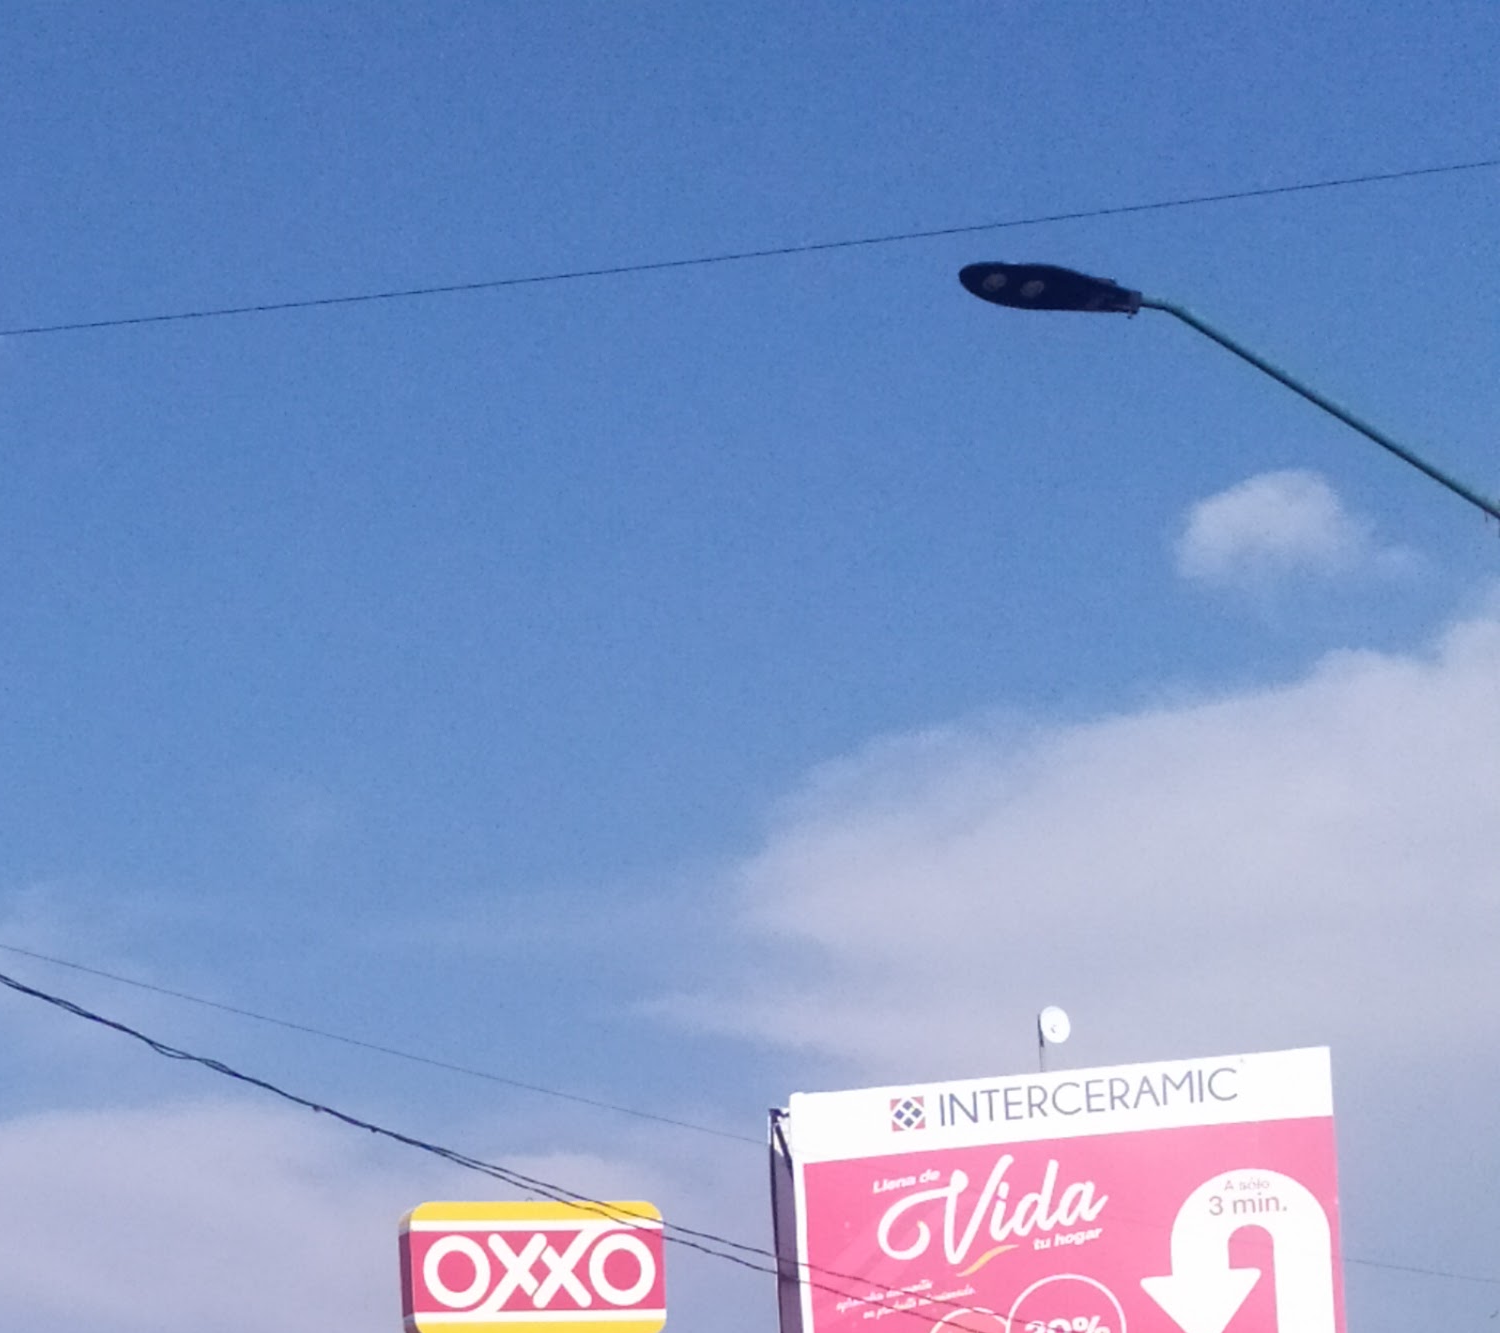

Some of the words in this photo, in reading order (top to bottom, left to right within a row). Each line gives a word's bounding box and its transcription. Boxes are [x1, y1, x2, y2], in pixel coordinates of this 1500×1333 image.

[938, 1067, 1238, 1127] INTERCERAMIC
[872, 1174, 916, 1194] Llena
[918, 1169, 940, 1184] de
[877, 1154, 1109, 1265] Vida
[1208, 1195, 1224, 1216] 3
[1233, 1191, 1288, 1215] min.
[1032, 1236, 1052, 1250] tu
[1054, 1227, 1103, 1248] hogar
[423, 1232, 656, 1309] OXXO
